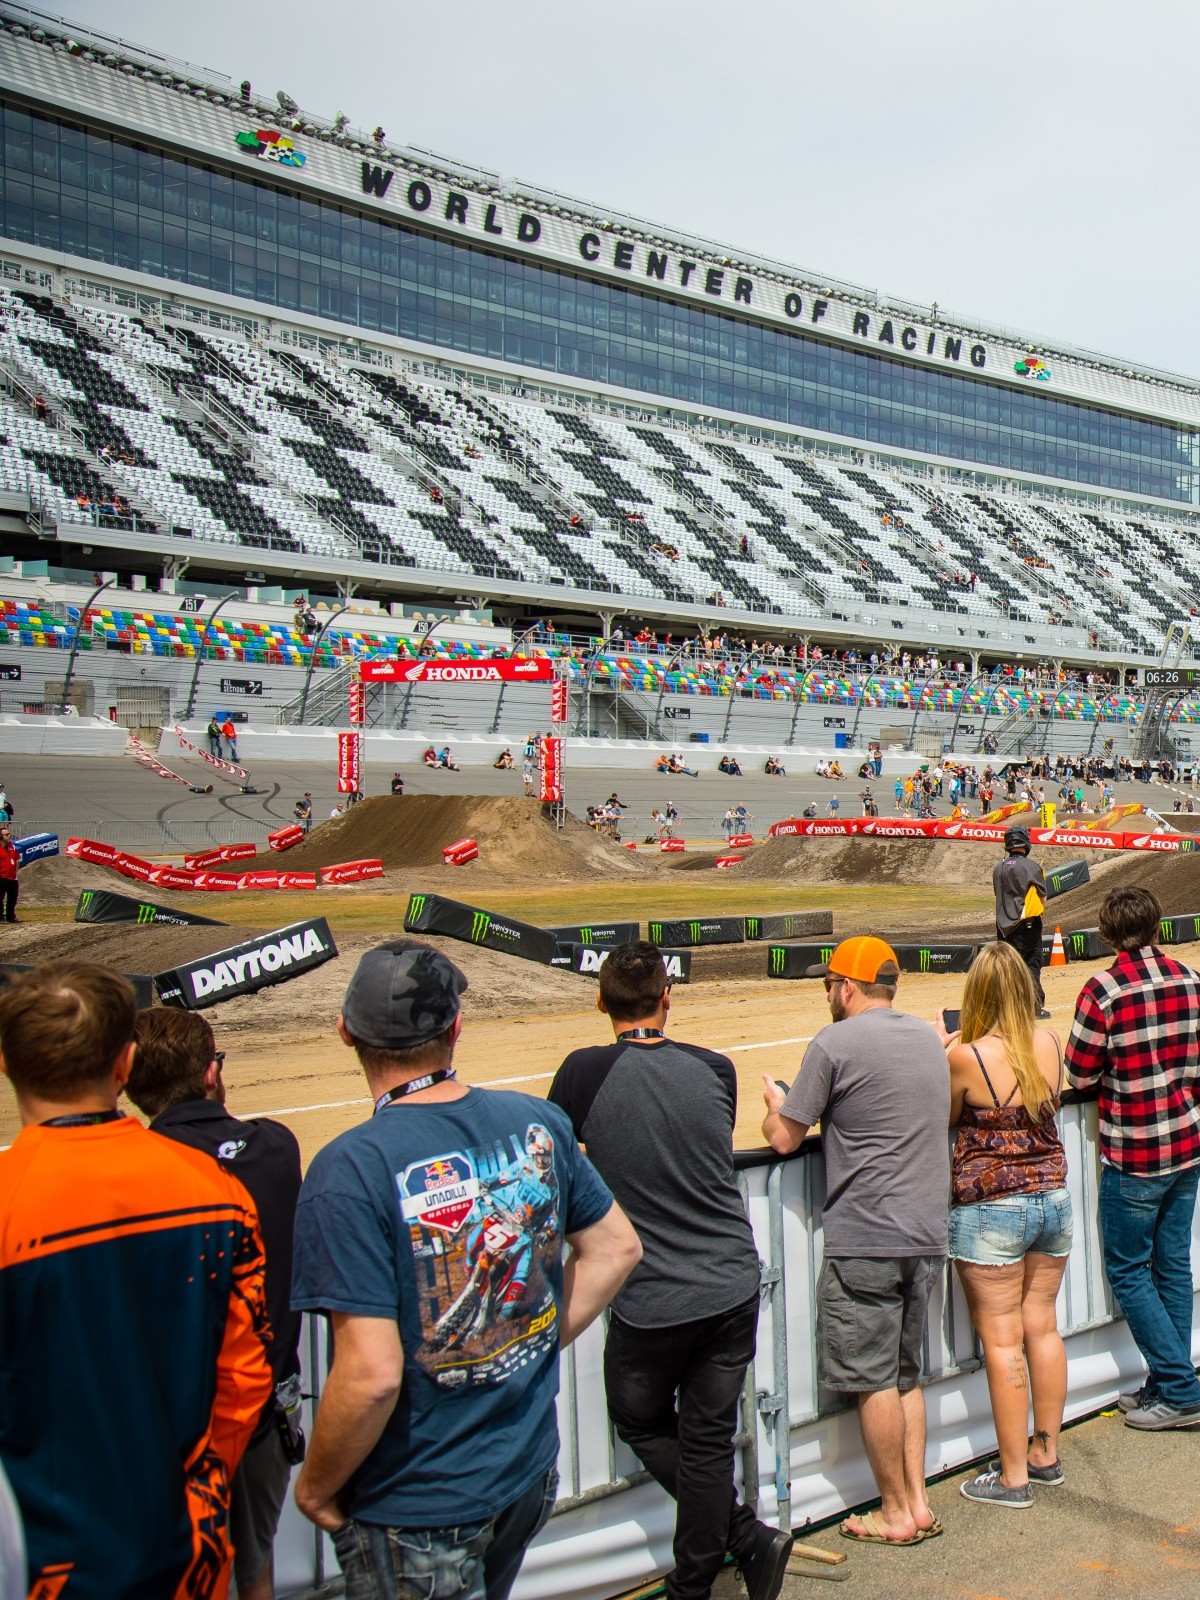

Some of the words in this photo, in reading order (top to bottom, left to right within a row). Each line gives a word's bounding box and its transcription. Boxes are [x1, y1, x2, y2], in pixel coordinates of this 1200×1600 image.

[361, 162, 541, 243] WORLD
[579, 233, 753, 304] CENTER
[785, 293, 827, 323] OF
[853, 312, 986, 367] RACING
[184, 598, 198, 611] 151
[426, 667, 503, 681] HONDA
[1146, 671, 1179, 683] 06:26
[778, 825, 798, 835] HONDA
[813, 825, 847, 835] HONDA
[875, 826, 926, 837] HONDA
[961, 828, 1005, 839] HOND
[1055, 834, 1115, 847] HONDA
[26, 839, 59, 855] COOPER
[42, 844, 59, 853] TIRES
[89, 848, 113, 860] HONDA
[202, 856, 221, 866] HONDA
[126, 862, 149, 875] HONDA
[340, 868, 359, 878] HONDA
[169, 875, 194, 885] HONDA
[214, 878, 237, 886] HONDA
[256, 876, 278, 884] HONDA
[295, 877, 317, 885] HONDA
[155, 913, 189, 926] MONSTER
[488, 922, 521, 939] MONSTER
[191, 928, 325, 999] DAYTONA
[424, 1185, 467, 1207] UNADILLA
[427, 1202, 470, 1219] NATIONAL
